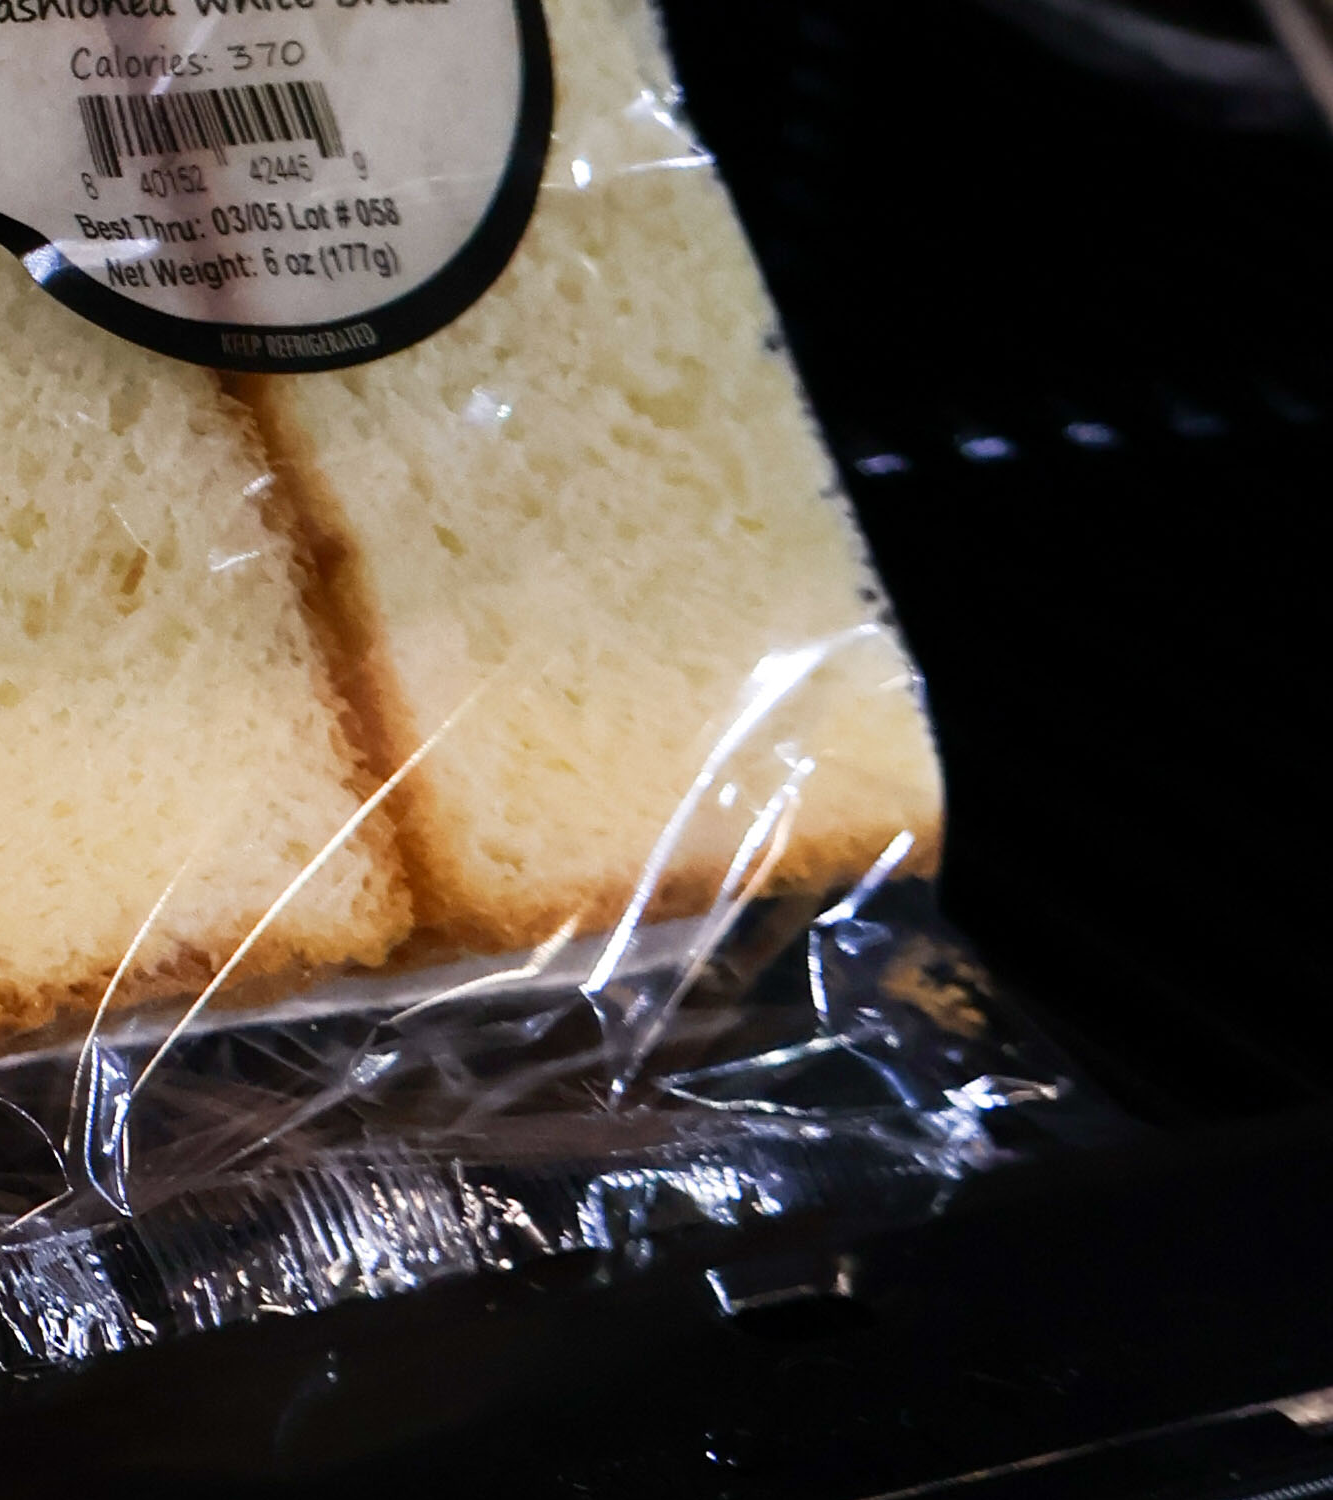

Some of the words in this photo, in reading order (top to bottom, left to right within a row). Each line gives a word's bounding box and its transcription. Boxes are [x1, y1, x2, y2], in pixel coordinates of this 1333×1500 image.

[70, 46, 213, 81] Calories:
[226, 40, 306, 72] 370
[140, 164, 208, 199] 40152
[75, 212, 134, 241] Best
[135, 213, 206, 242] Thru:
[211, 202, 284, 235] 03/05
[286, 201, 331, 230] Lot
[334, 200, 352, 229] #
[355, 197, 401, 227] 058
[106, 256, 149, 288] Net
[153, 250, 259, 290] Weight:
[263, 247, 281, 276] 6
[285, 253, 316, 275] oz
[318, 241, 403, 281] (177g)
